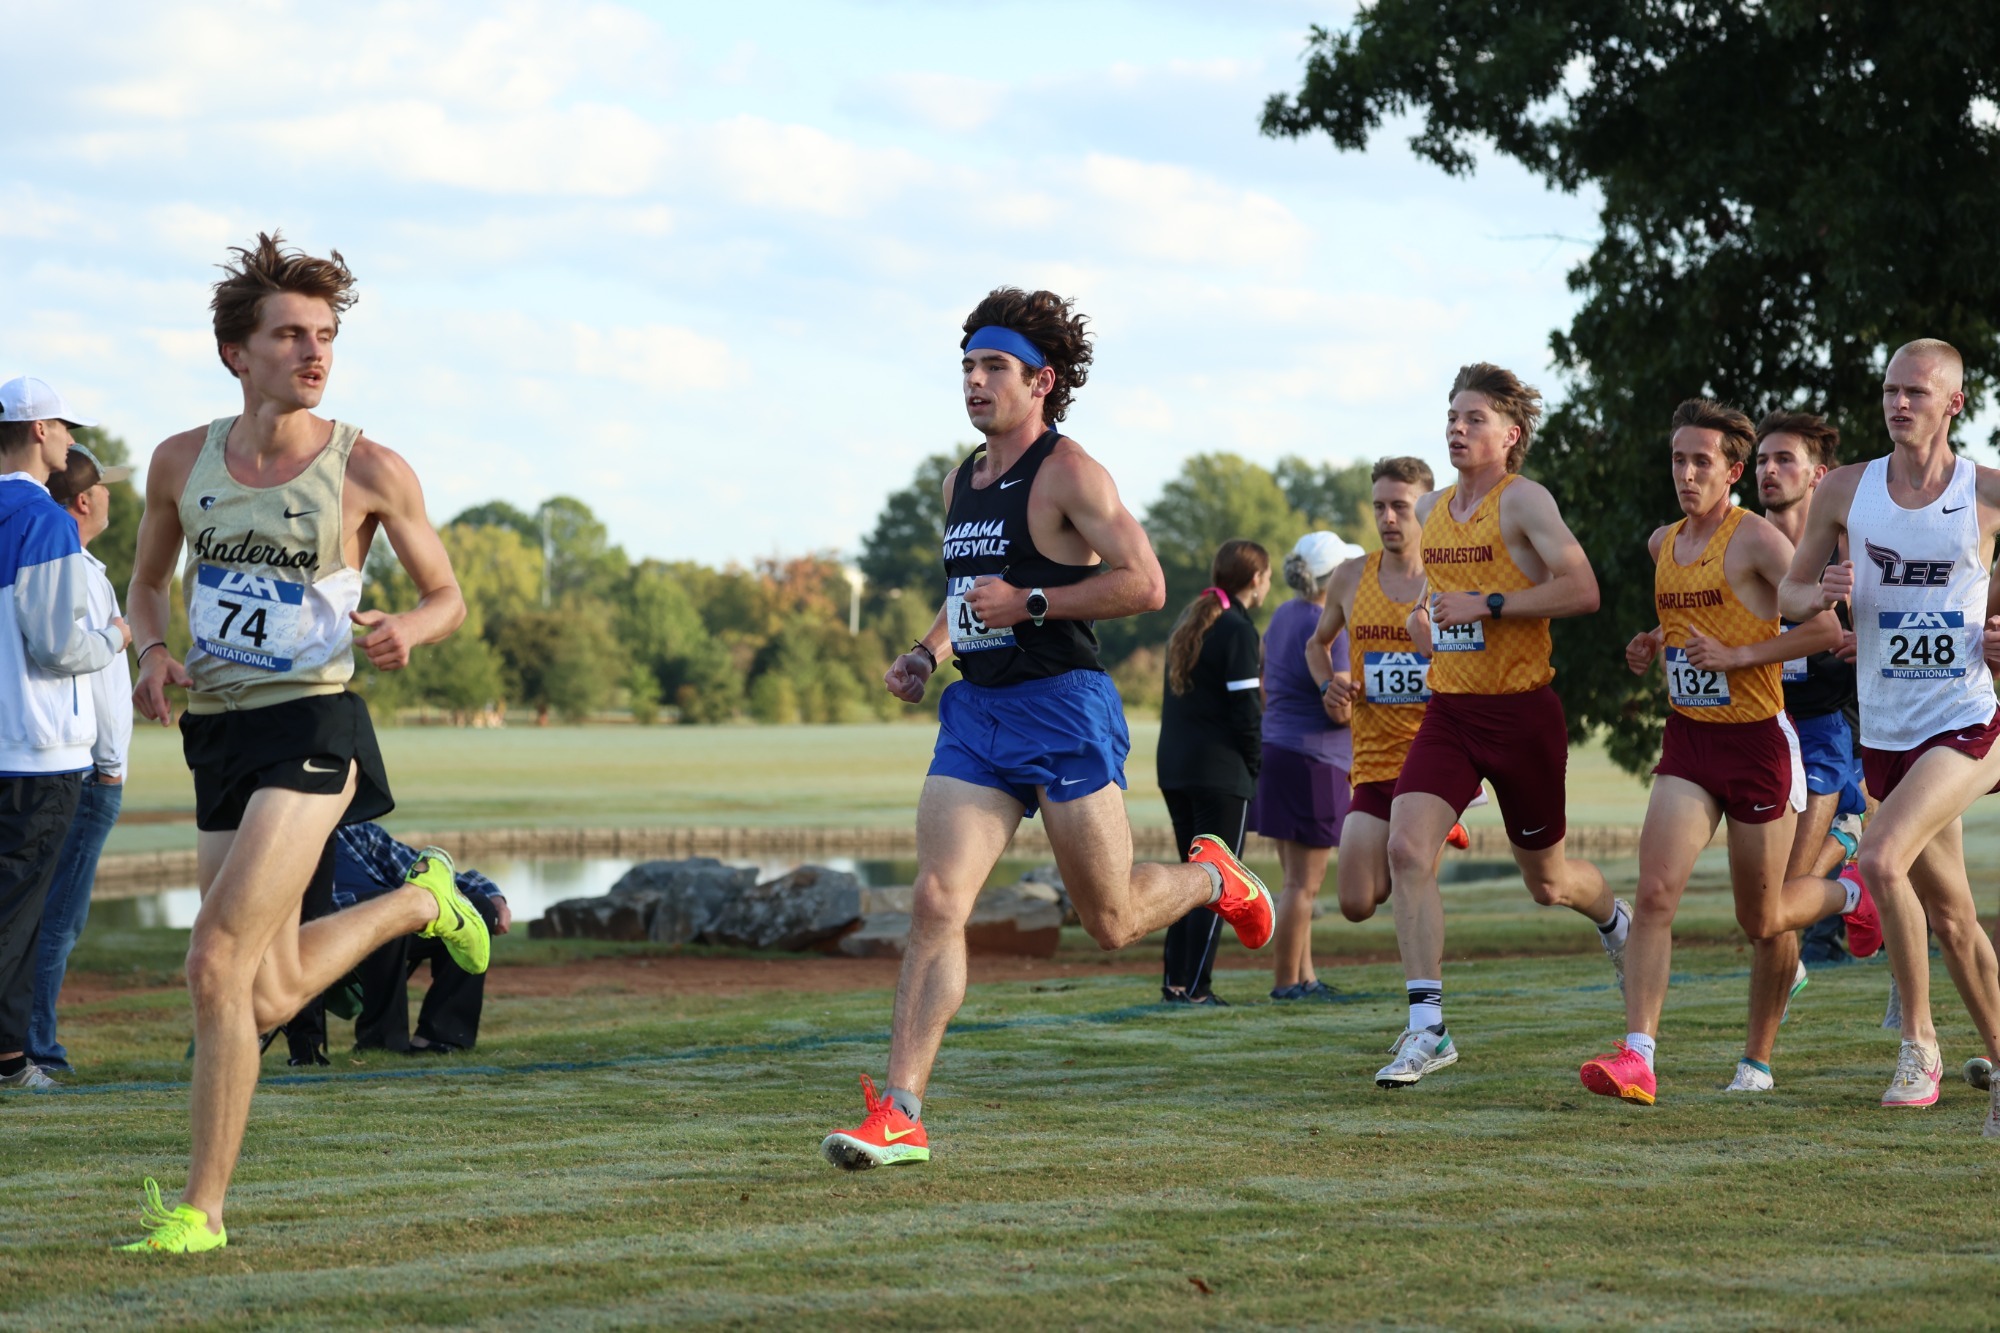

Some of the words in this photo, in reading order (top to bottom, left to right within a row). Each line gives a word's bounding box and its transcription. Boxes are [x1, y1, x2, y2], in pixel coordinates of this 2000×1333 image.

[1423, 545, 1494, 564] CHARLESTON
[1880, 560, 1955, 587] LEE
[1657, 589, 1724, 610] HARLESTON
[218, 600, 268, 648] 74
[1355, 625, 1412, 642] CHARLES
[957, 637, 1007, 651] INVITATIONAL
[1437, 643, 1477, 651] INVITATIONAL
[1889, 634, 1955, 665] 248
[205, 642, 276, 668] INVITATIONAL
[1373, 670, 1423, 694] 135
[1672, 667, 1720, 695] 132
[1892, 669, 1954, 679] INVITATIONAL
[1374, 695, 1423, 703] INVITATIONAL
[1676, 698, 1721, 706] INVITATIONAL
